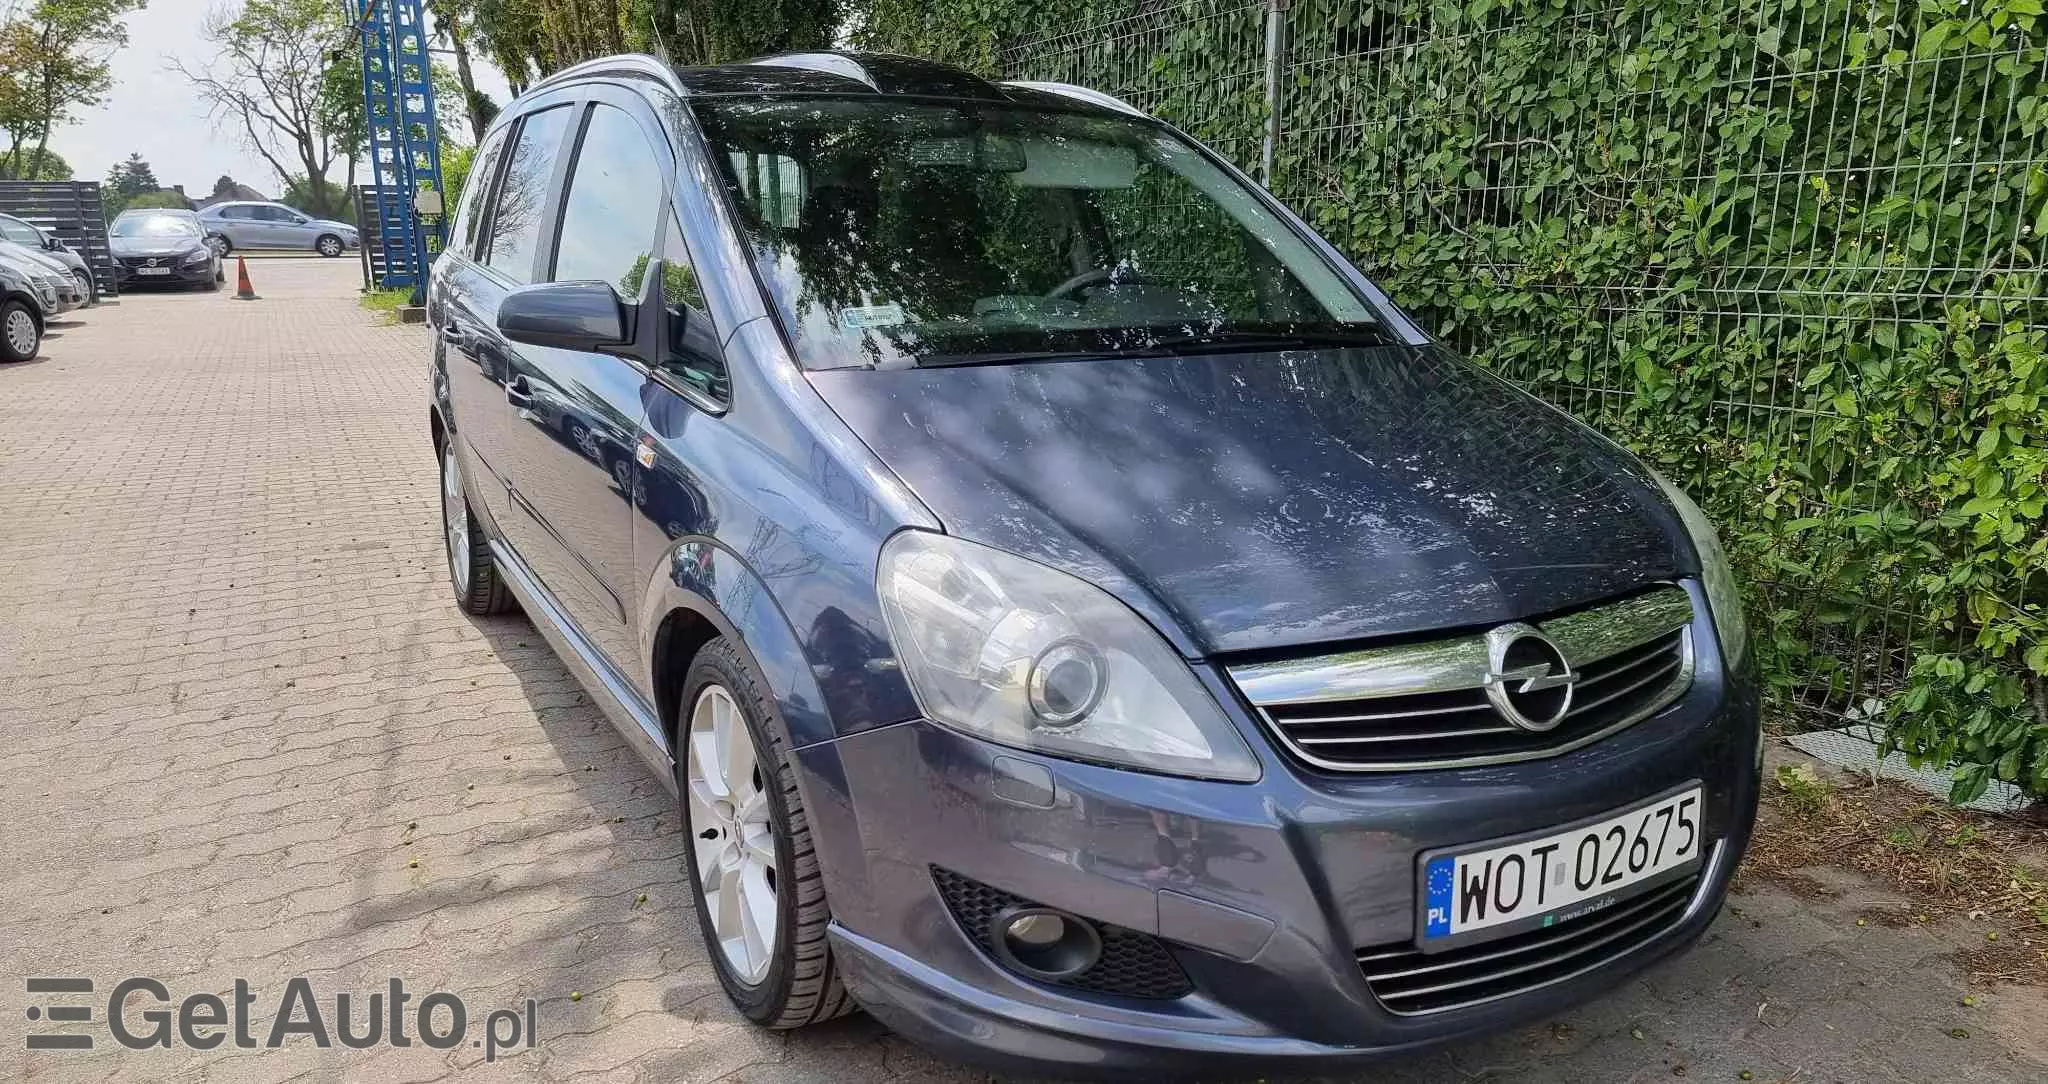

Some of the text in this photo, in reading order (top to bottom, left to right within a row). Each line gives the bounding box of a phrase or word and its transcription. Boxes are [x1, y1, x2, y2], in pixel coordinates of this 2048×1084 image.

[1460, 796, 1696, 924] WOT 02675
[1427, 907, 1449, 926] PL
